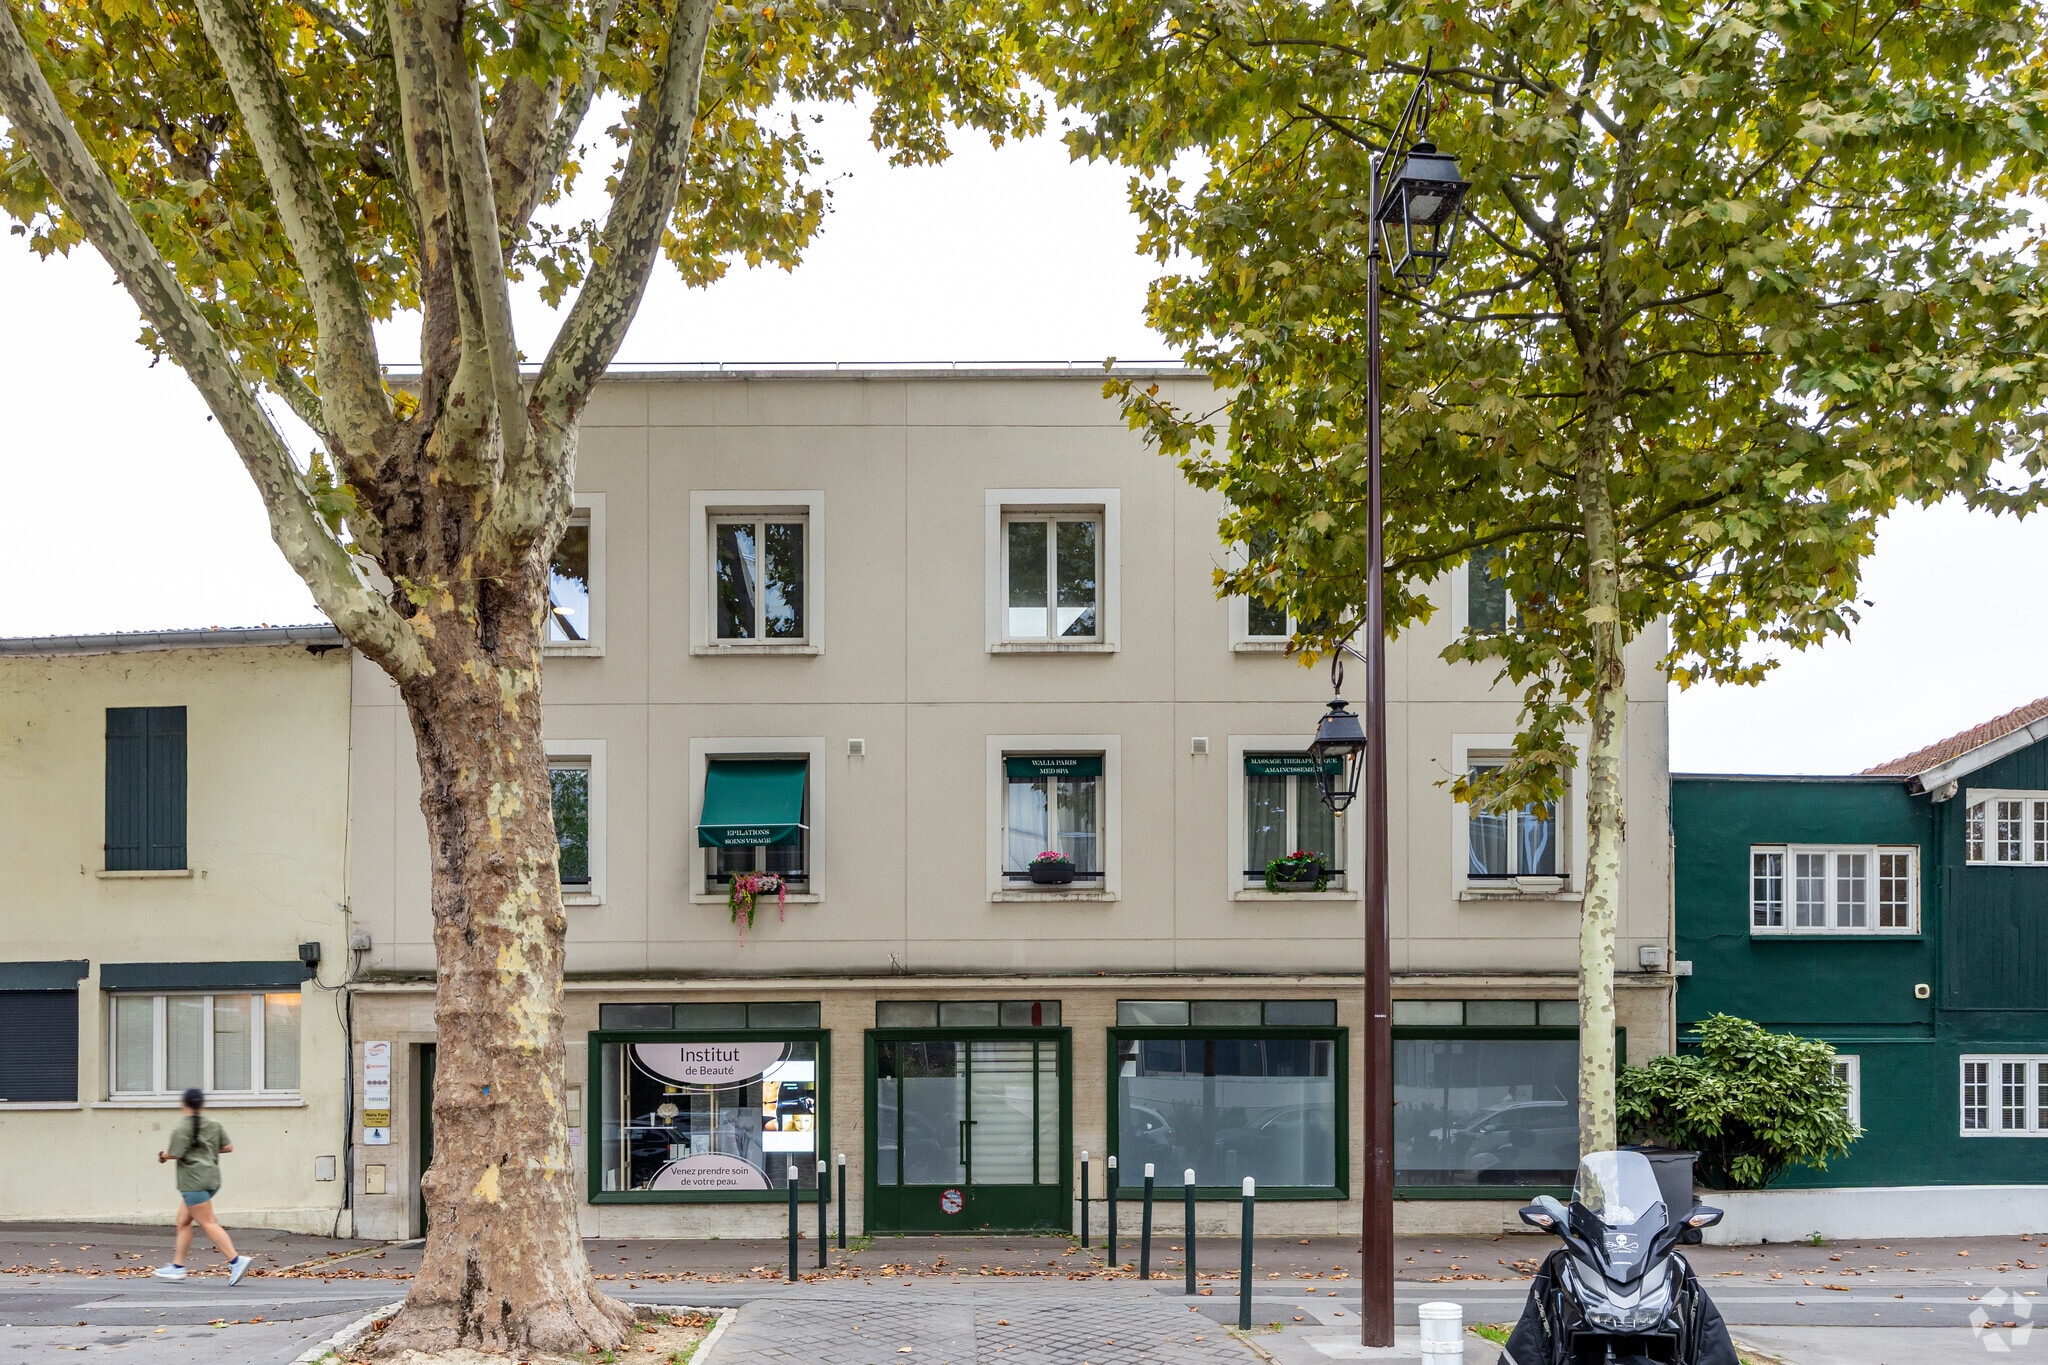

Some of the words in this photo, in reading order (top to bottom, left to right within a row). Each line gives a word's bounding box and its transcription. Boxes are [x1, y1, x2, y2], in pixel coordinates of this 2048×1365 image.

[680, 1047, 740, 1062] Institut
[685, 1066, 697, 1075] de
[700, 1065, 735, 1075] Beauté
[671, 1167, 696, 1175] Venez
[698, 1166, 730, 1177] prendre
[731, 1166, 749, 1175] soin
[681, 1177, 691, 1185] de
[717, 1178, 739, 1187] peau.
